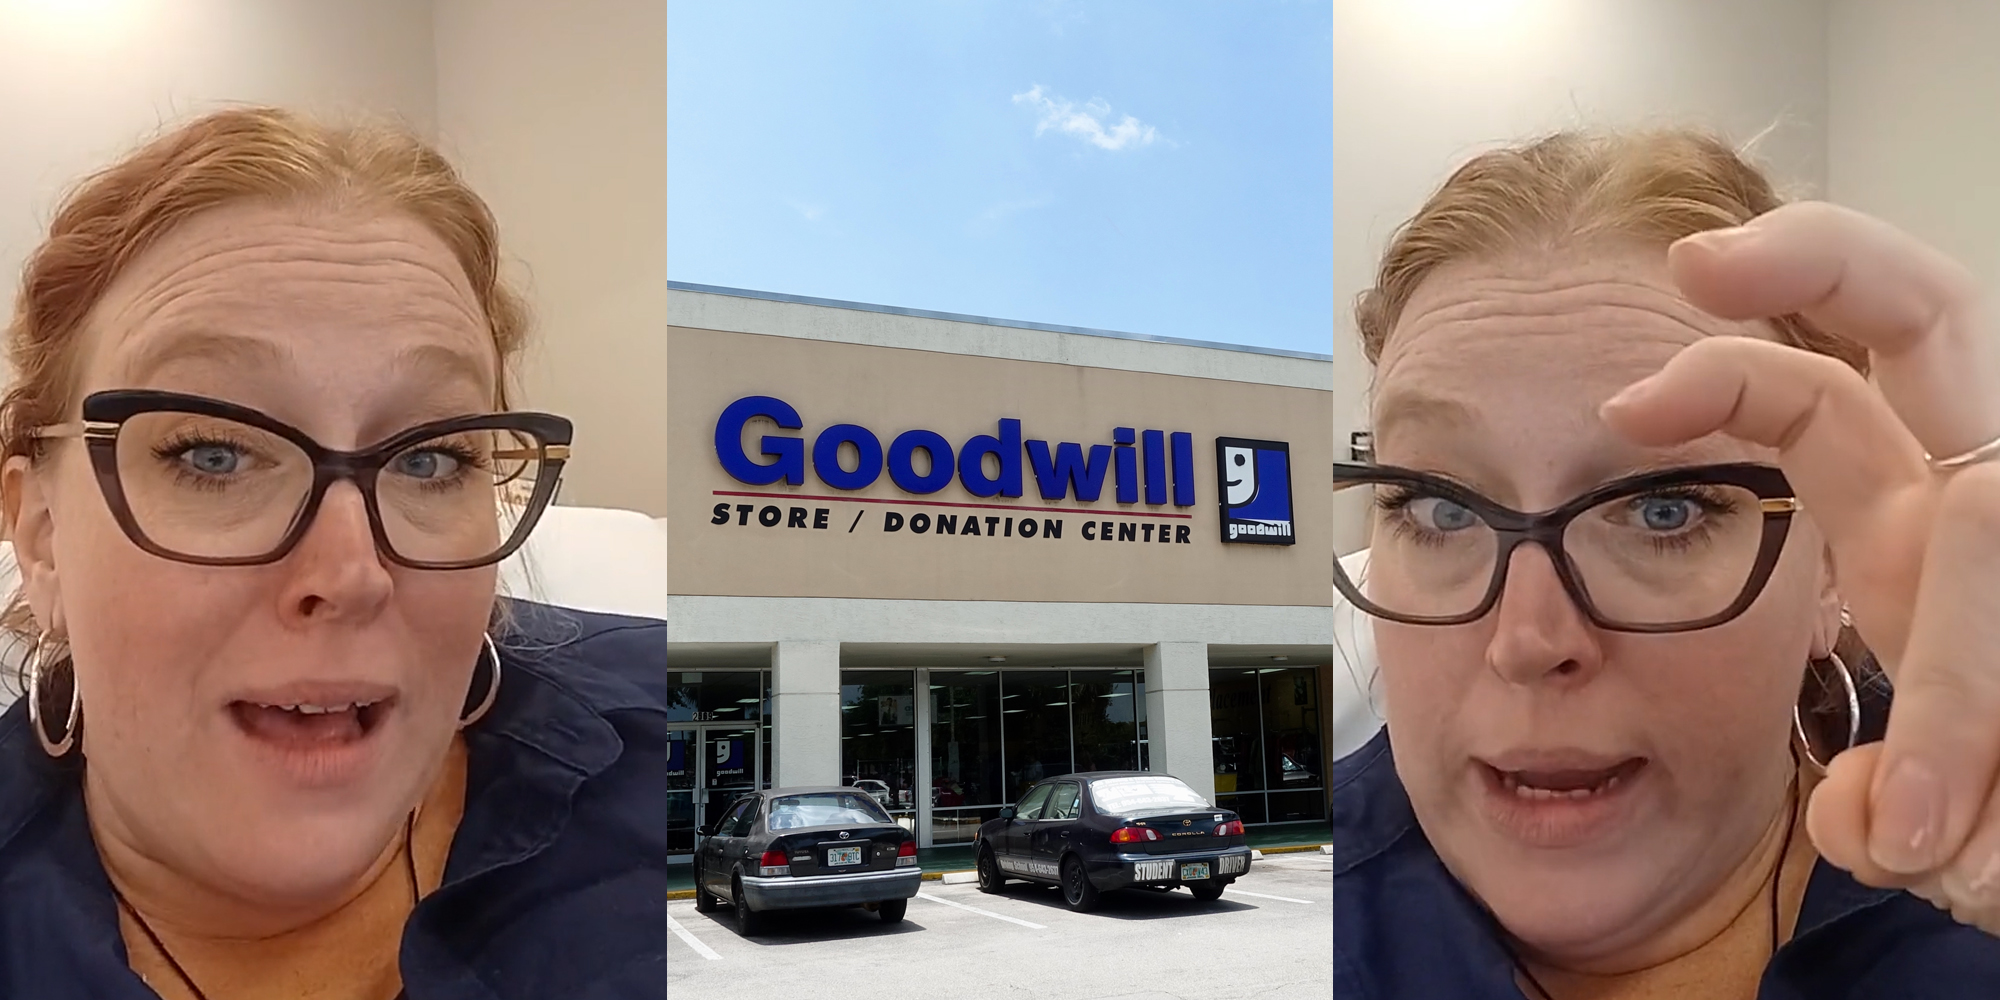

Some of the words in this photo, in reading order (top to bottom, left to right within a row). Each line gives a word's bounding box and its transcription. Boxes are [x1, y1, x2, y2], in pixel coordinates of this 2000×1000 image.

[714, 395, 1196, 507] Goodwill
[711, 502, 830, 530] STORE
[848, 509, 866, 533] /
[884, 511, 1063, 539] DONATION
[1081, 521, 1192, 544] CENTER
[1229, 520, 1292, 540] goodwill
[716, 768, 744, 777] goodwill
[1134, 861, 1174, 882] STUDENT
[1218, 855, 1246, 875] DRIVER
